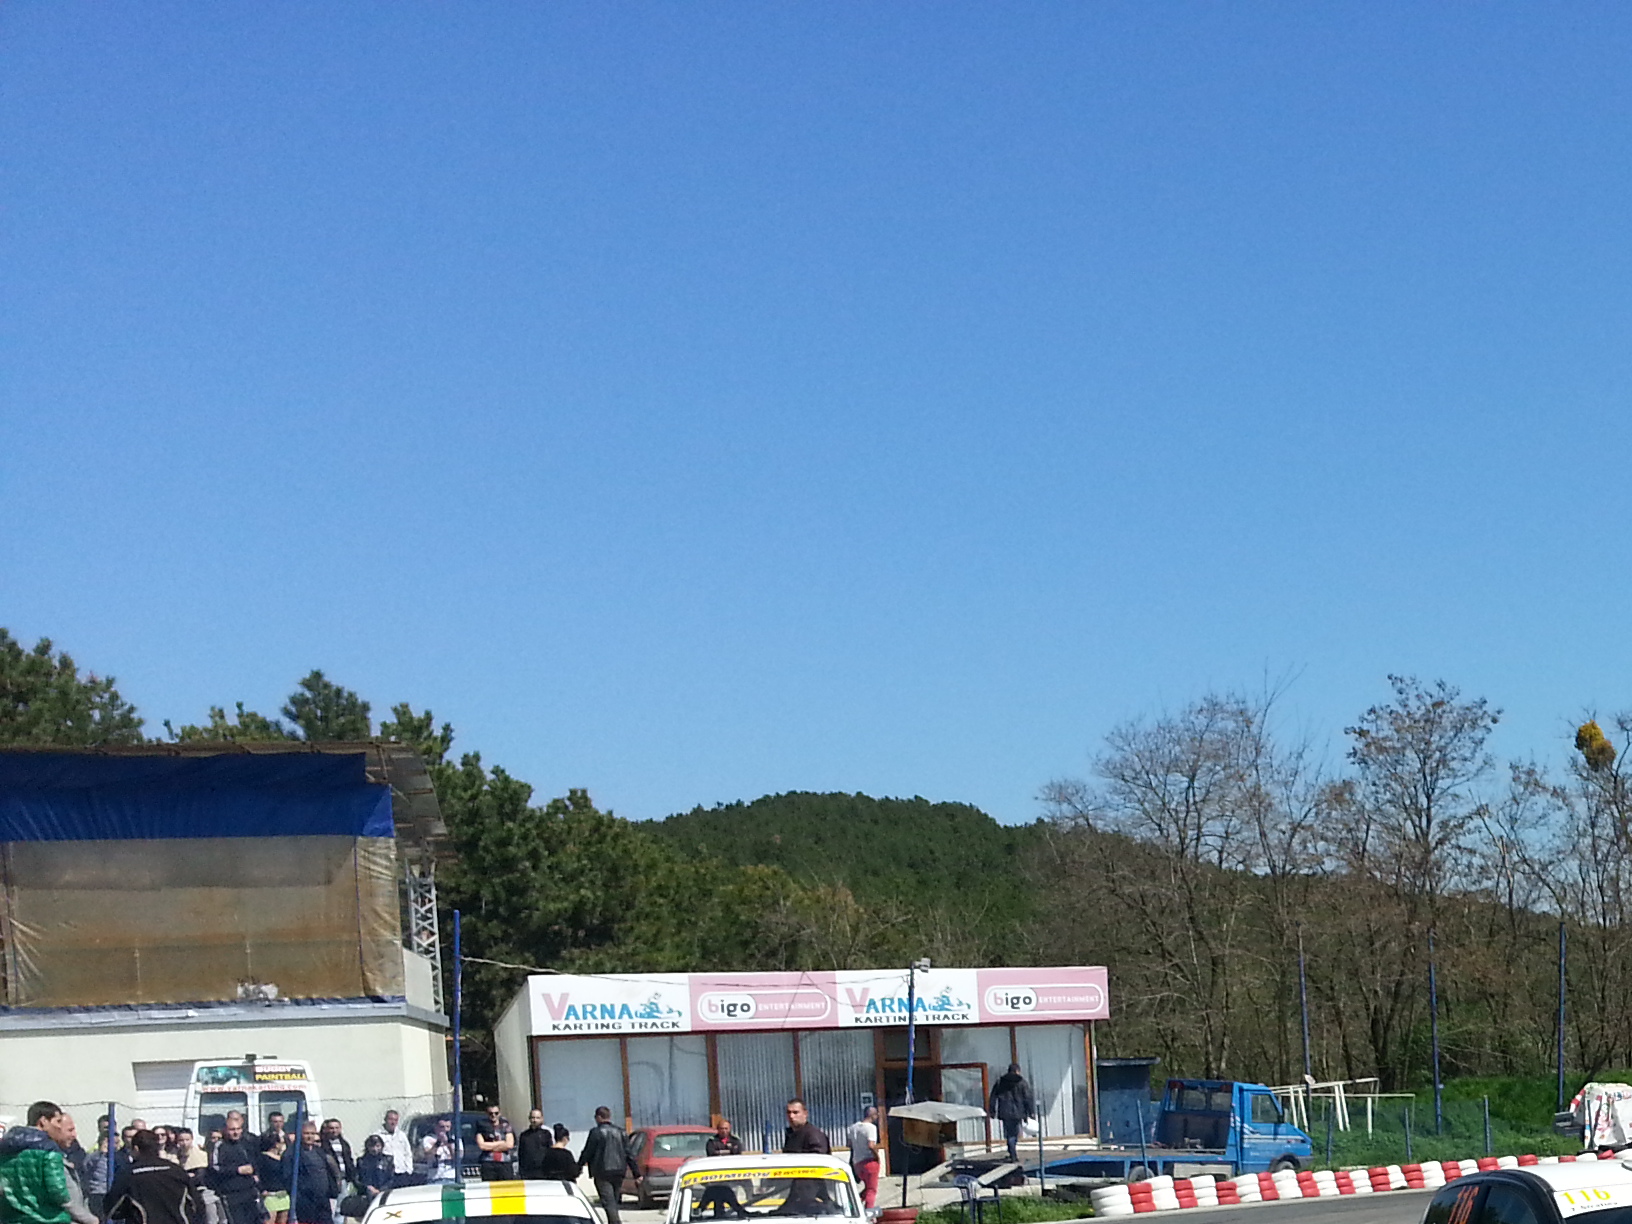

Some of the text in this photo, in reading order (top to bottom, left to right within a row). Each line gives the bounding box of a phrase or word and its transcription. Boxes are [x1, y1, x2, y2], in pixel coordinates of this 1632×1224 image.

[542, 992, 633, 1021] VARNA
[707, 997, 751, 1018] bigo
[845, 987, 928, 1015] VARNA
[993, 992, 1032, 1009] bigo
[552, 1020, 680, 1031] KARTING TRACK
[924, 1013, 970, 1021] TRACK
[255, 1072, 307, 1080] PAINTBALL
[1560, 1188, 1611, 1205] 116
